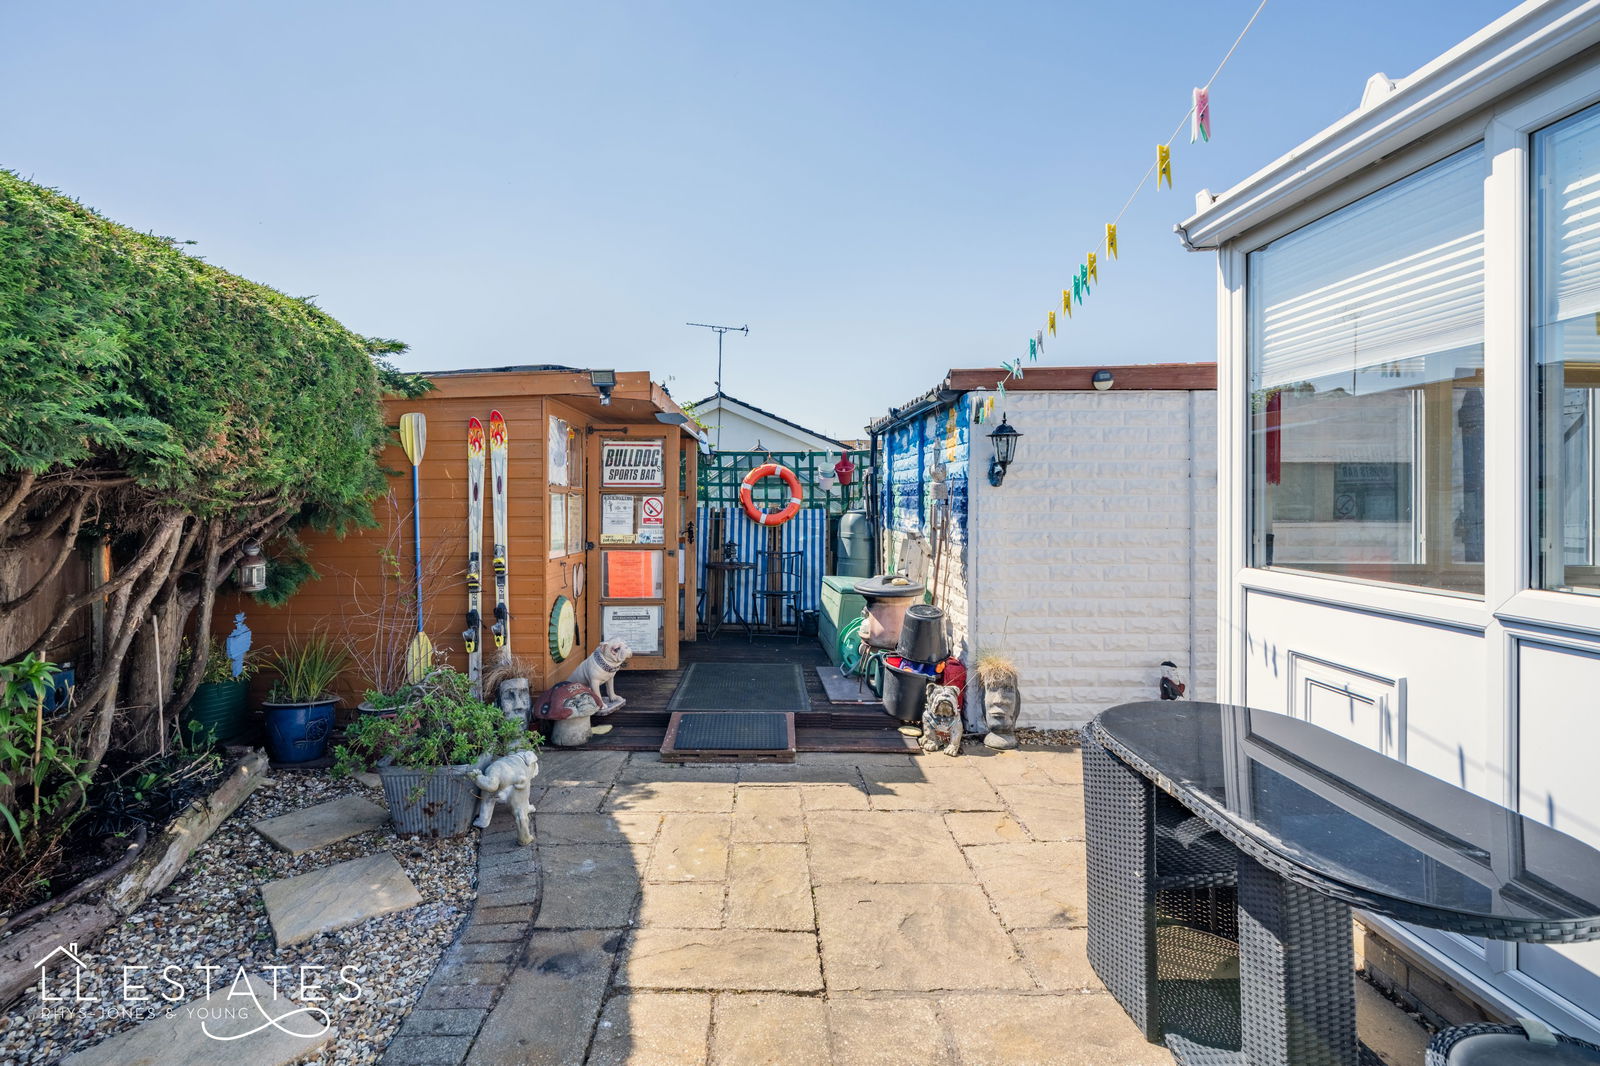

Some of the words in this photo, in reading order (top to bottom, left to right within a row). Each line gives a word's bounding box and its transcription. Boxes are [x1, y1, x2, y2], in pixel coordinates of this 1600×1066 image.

[605, 449, 660, 467] BULLDOG
[608, 469, 638, 481] SPORTS
[640, 469, 656, 481] BAR
